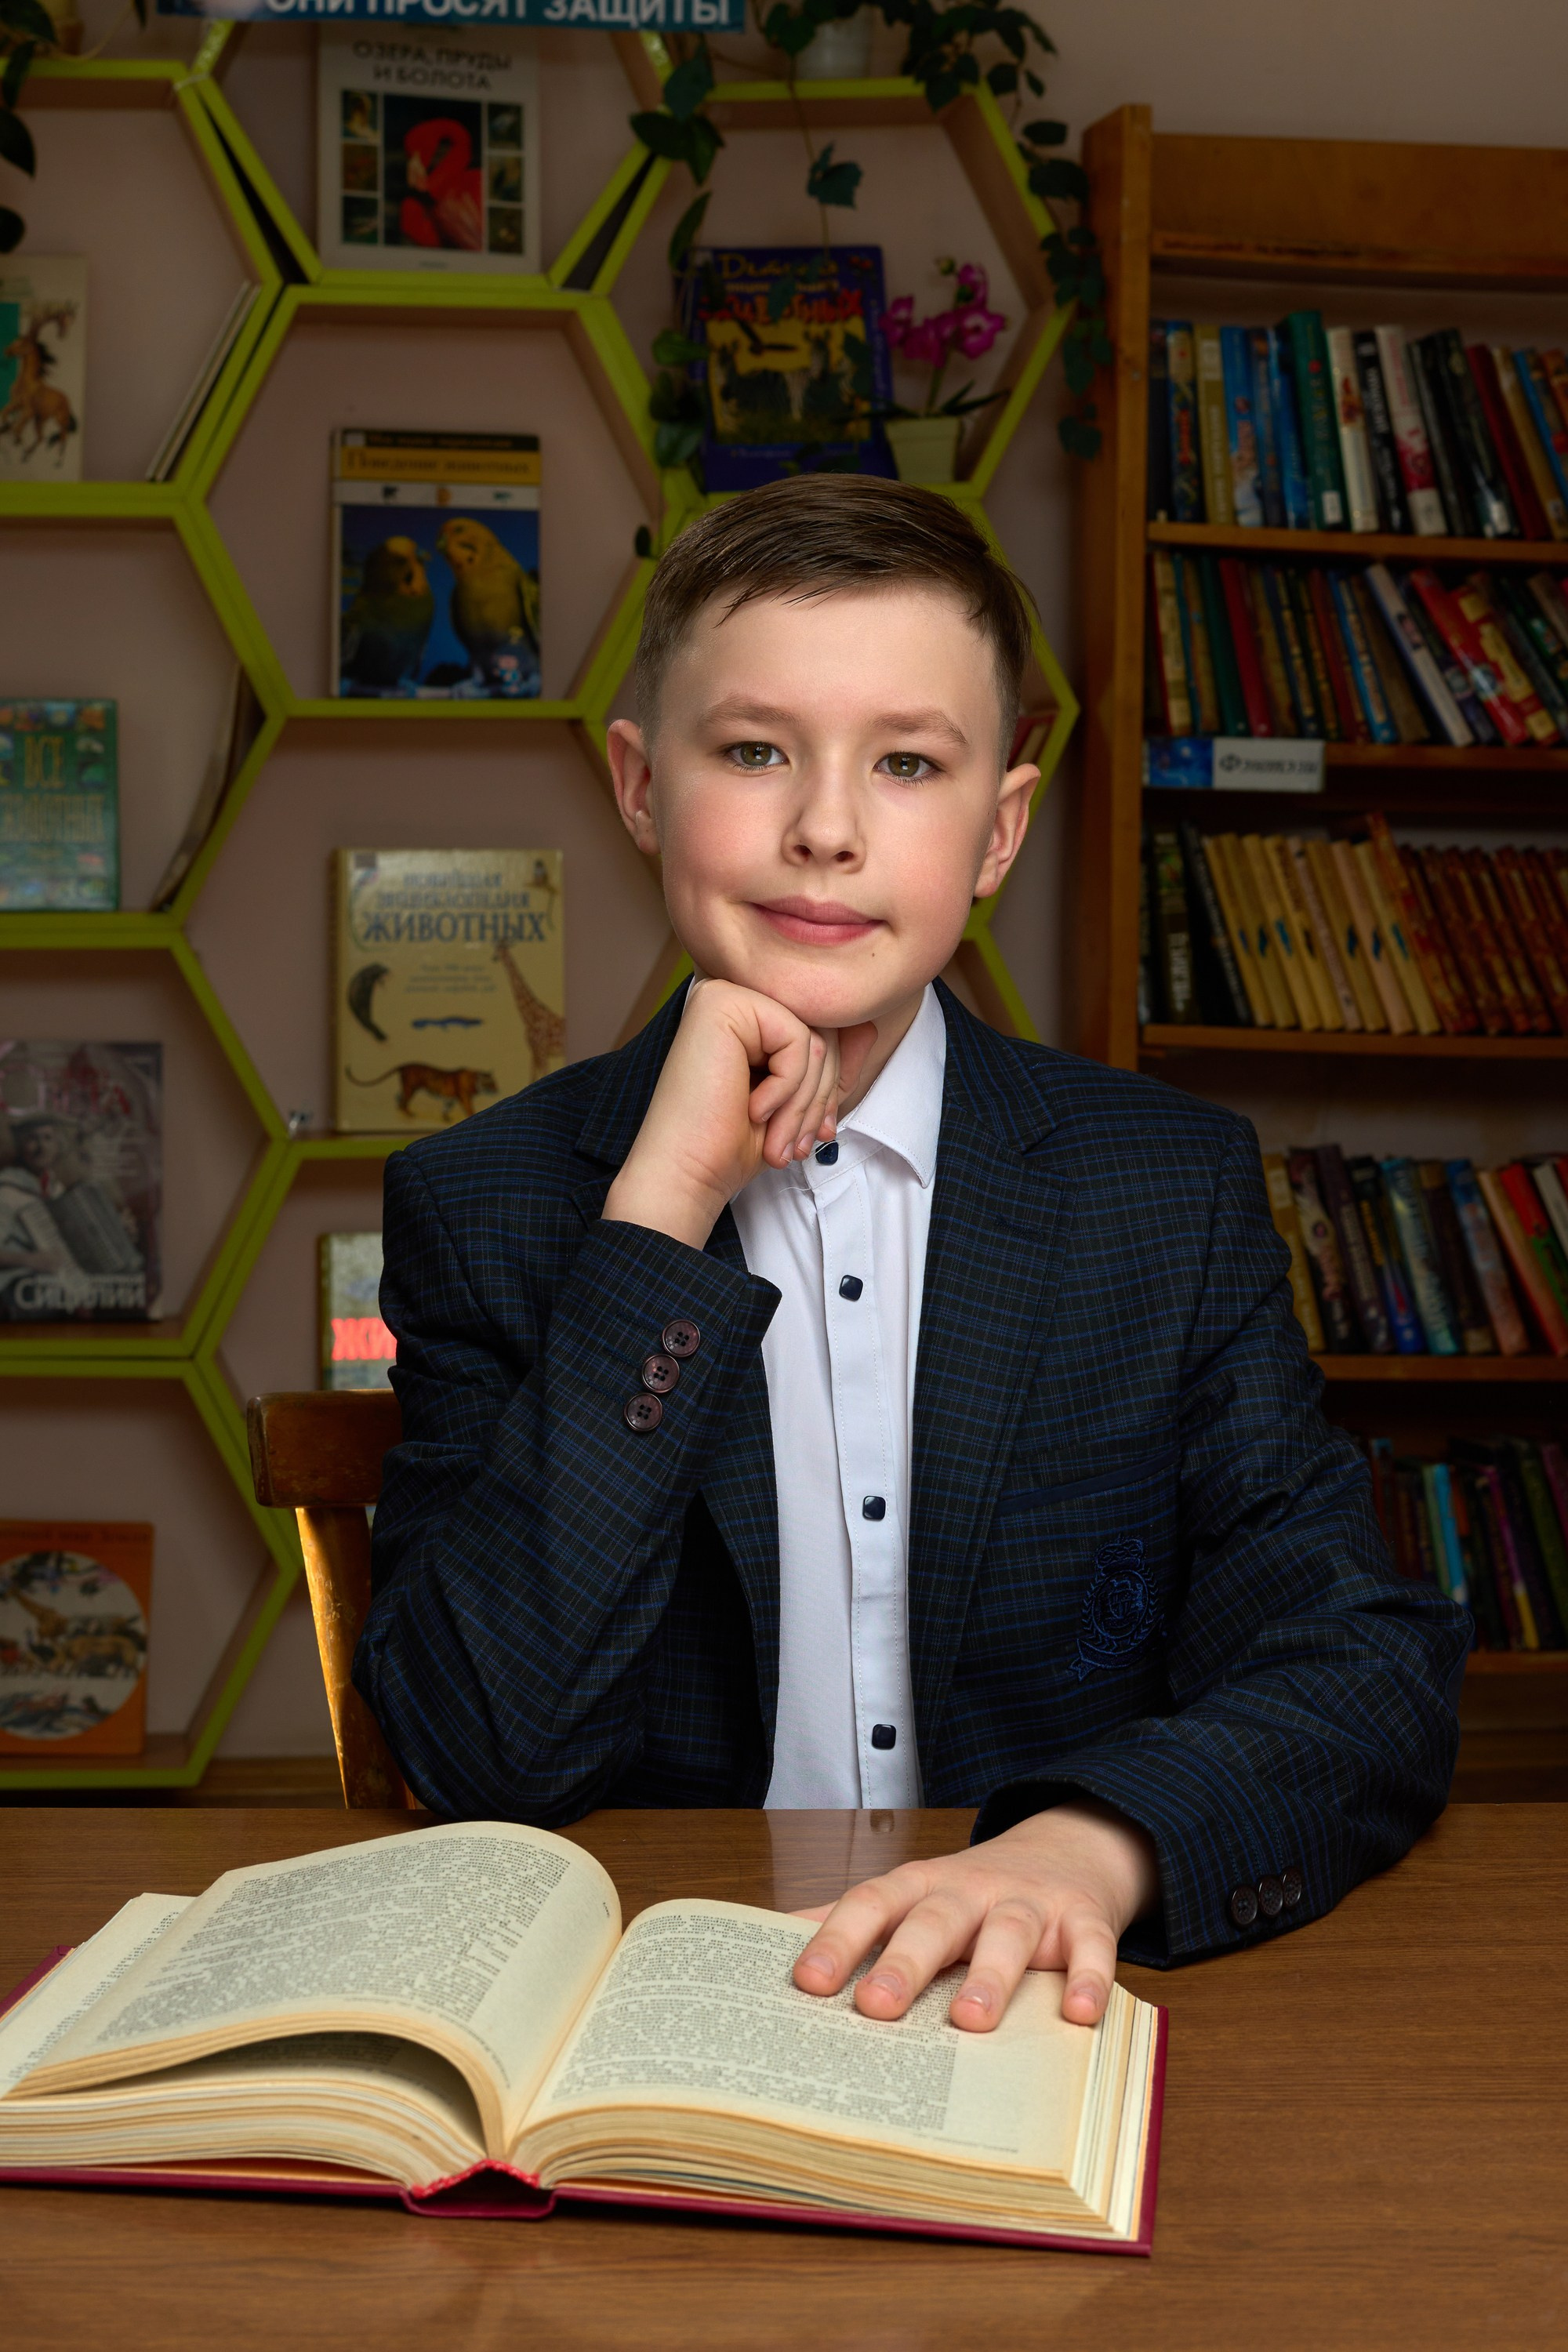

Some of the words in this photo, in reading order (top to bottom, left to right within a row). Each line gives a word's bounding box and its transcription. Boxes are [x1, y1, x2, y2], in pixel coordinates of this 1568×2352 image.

[366, 0, 527, 18] ПРОСЯТ
[543, 0, 730, 28] ЗАЩИТЫ
[353, 40, 432, 66] ОЗЕРА,
[436, 46, 513, 71] ПРУДЫ
[373, 65, 391, 80] И
[395, 66, 491, 90] БОЛОТА
[362, 911, 546, 942] ЖИВОТНЫХ
